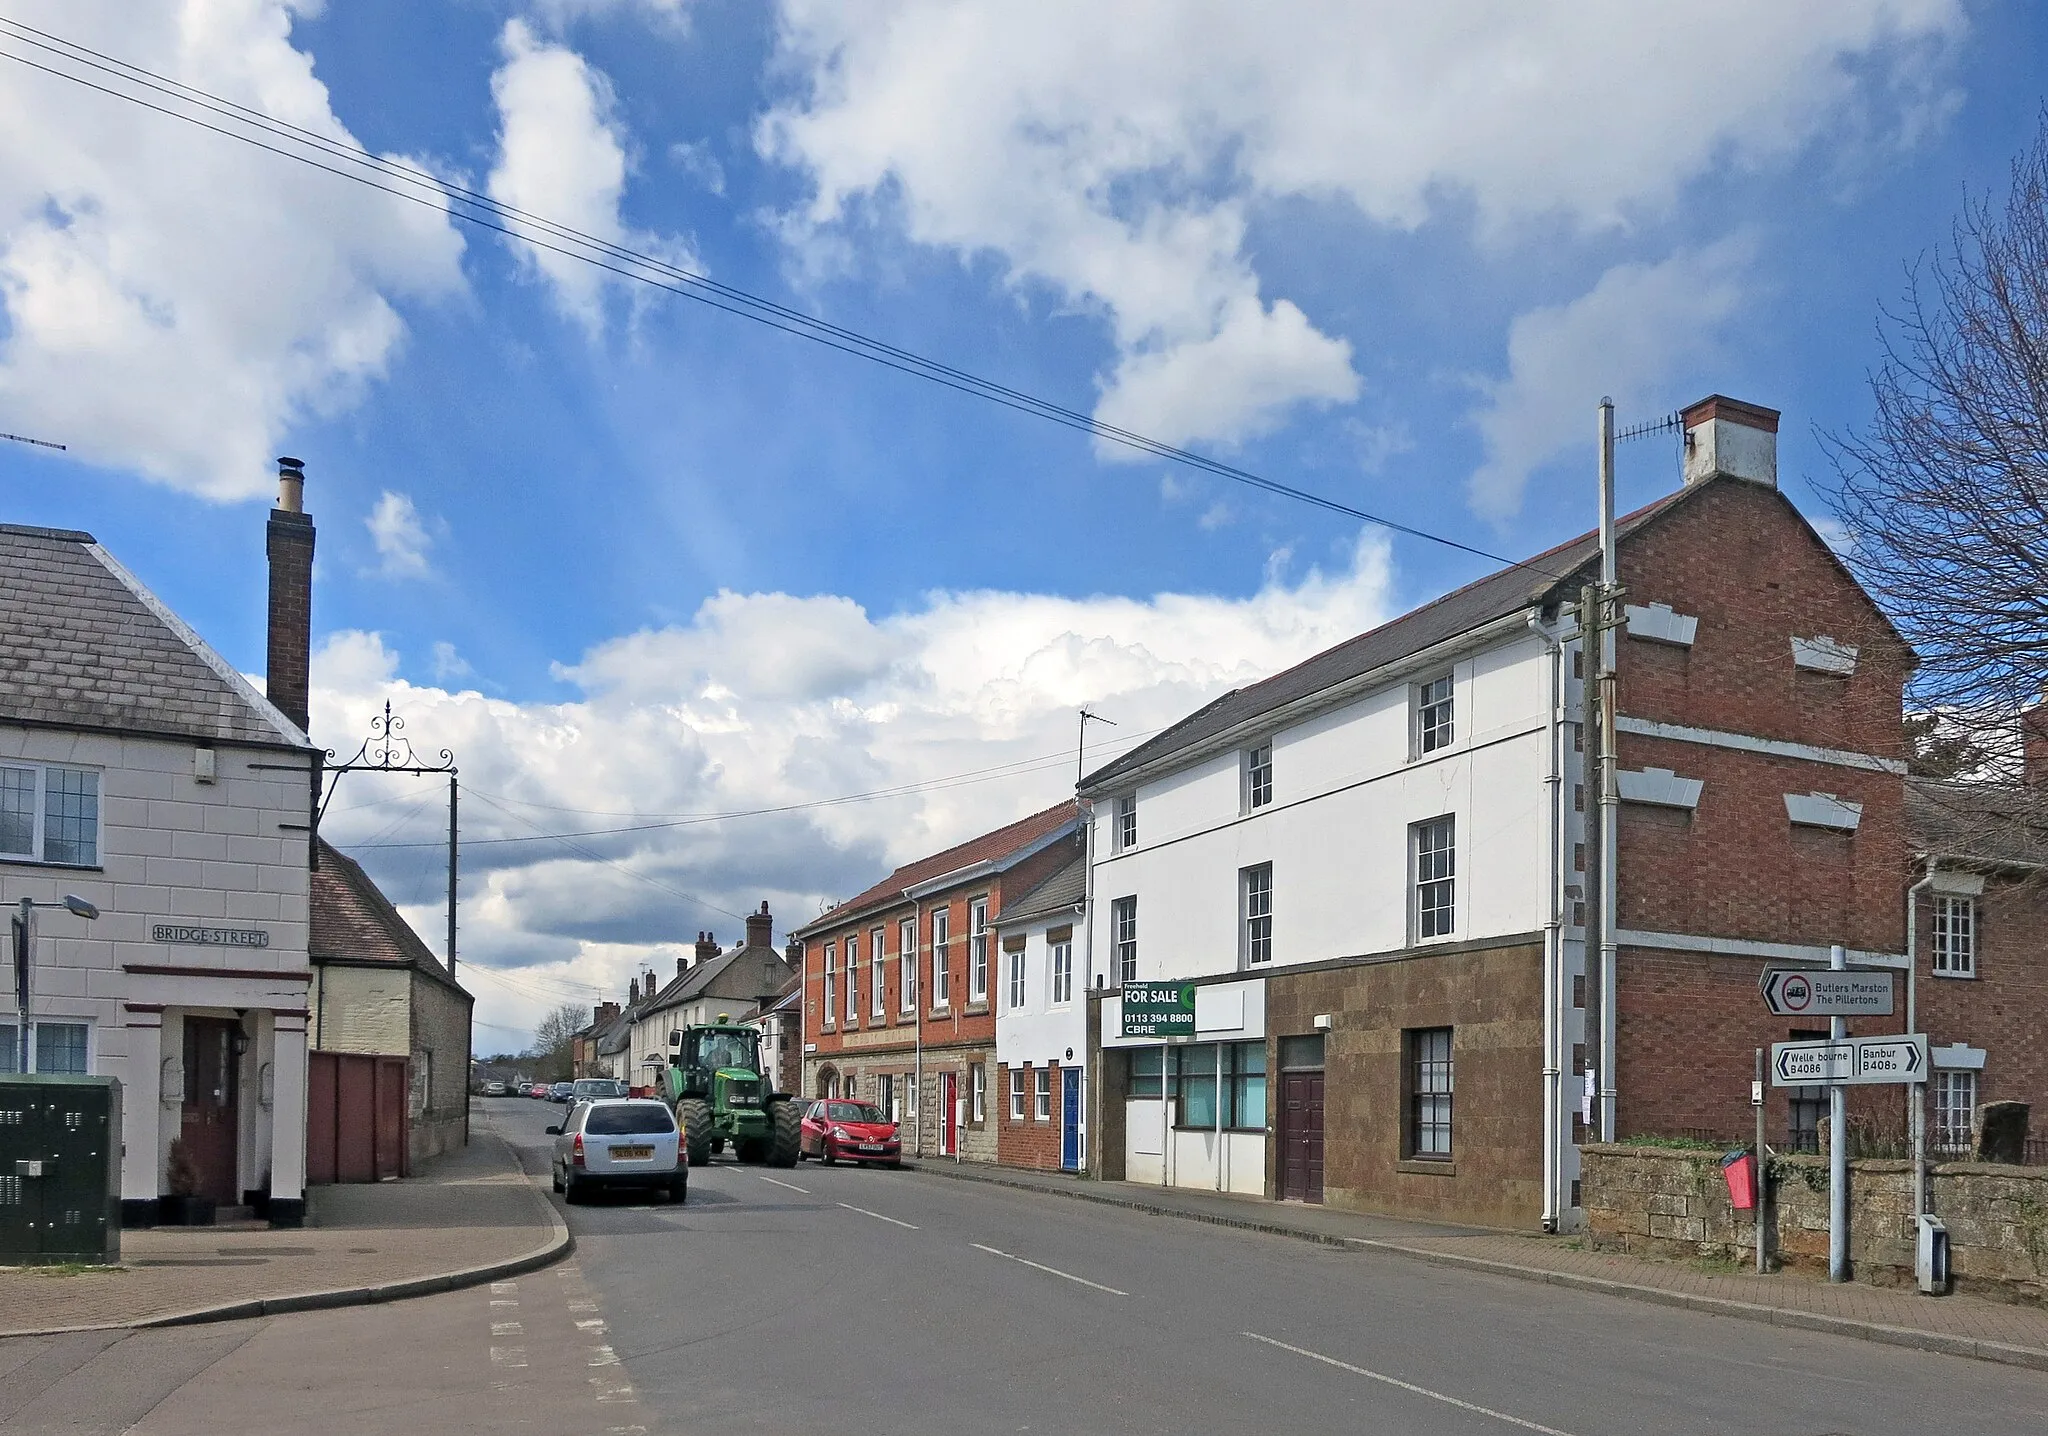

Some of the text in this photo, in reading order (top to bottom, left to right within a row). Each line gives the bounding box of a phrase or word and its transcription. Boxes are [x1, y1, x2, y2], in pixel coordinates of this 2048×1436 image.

[156, 927, 264, 945] BRIDGE STREET
[1815, 983, 1888, 993] Butlers Marston
[1124, 990, 1178, 1003] FOR SALE
[1816, 994, 1879, 1004] The Pillertons
[1124, 1013, 1193, 1023] 0113 394 8800
[1125, 1025, 1156, 1034] CBRE
[1790, 1052, 1848, 1063] Welle bourne
[1791, 1064, 1821, 1073] B4086
